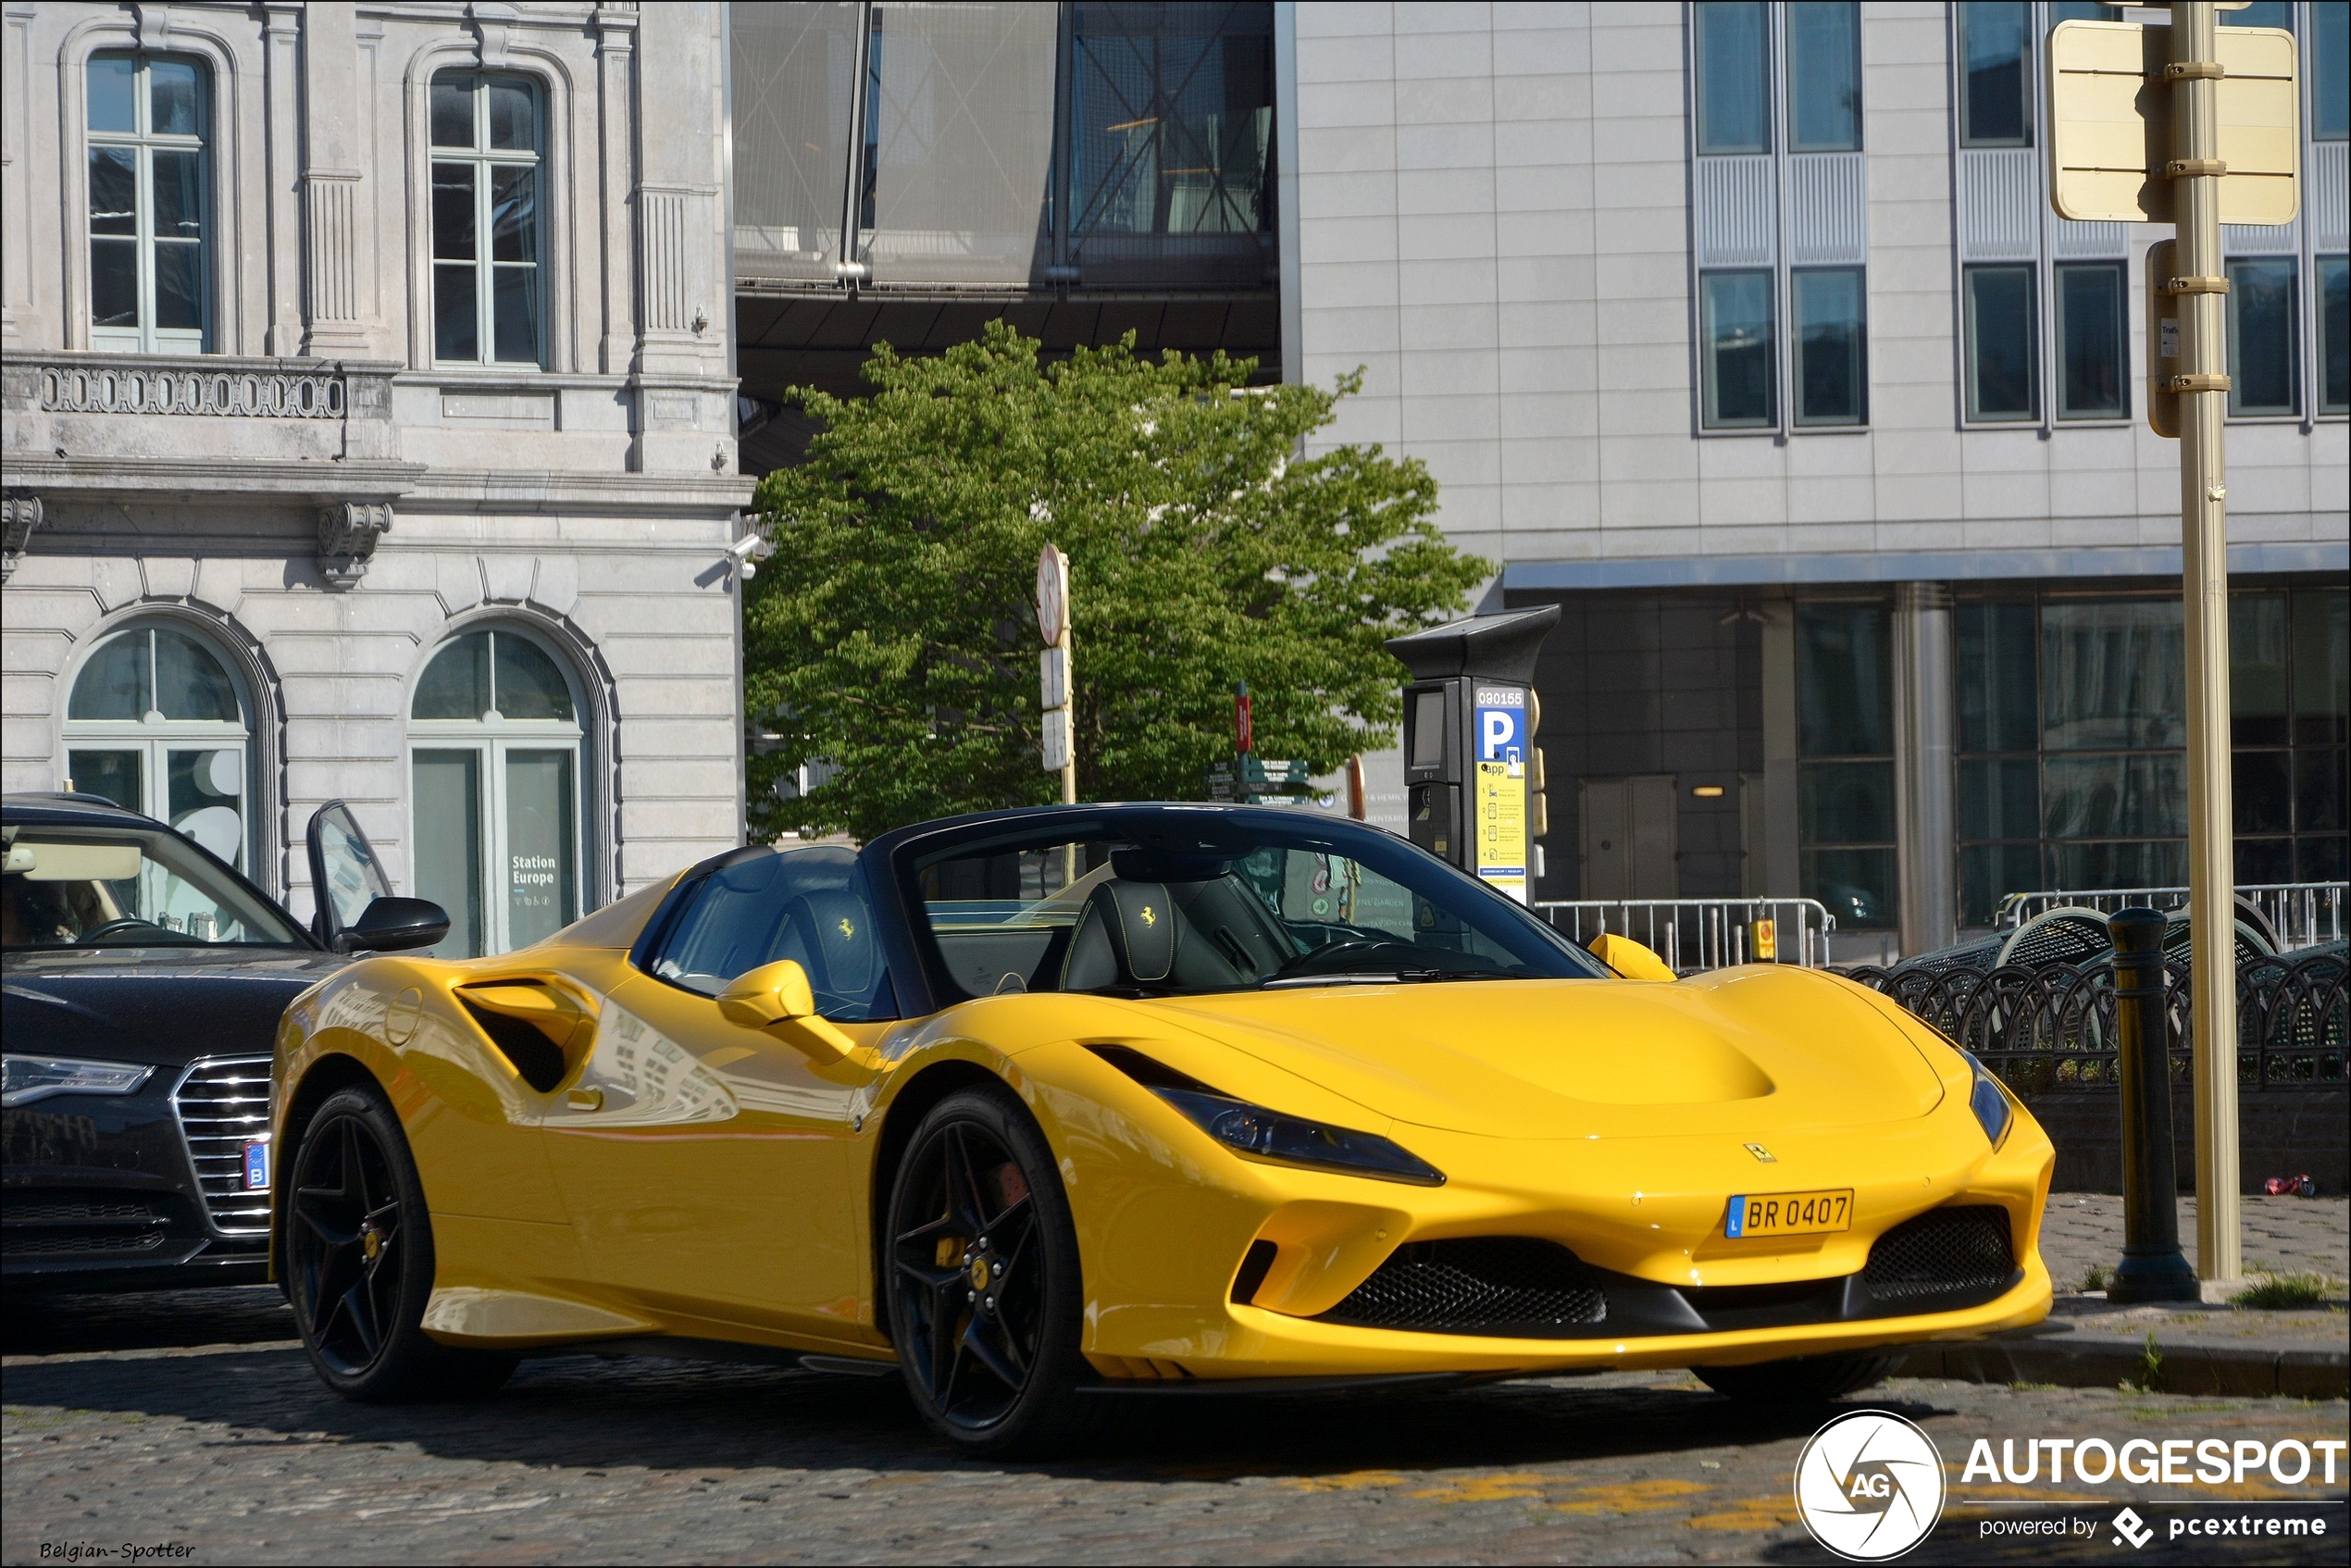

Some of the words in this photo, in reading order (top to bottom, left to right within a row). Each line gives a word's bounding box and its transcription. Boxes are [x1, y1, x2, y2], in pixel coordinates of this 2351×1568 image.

[1478, 692, 1523, 705] 090155
[1483, 711, 1514, 759] P
[1486, 765, 1504, 777] app
[512, 855, 556, 869] Station
[513, 871, 554, 887] Europe
[250, 1168, 263, 1184] B
[1748, 1201, 1779, 1229] BR
[1785, 1197, 1847, 1226] 0407
[1731, 1219, 1737, 1231] L
